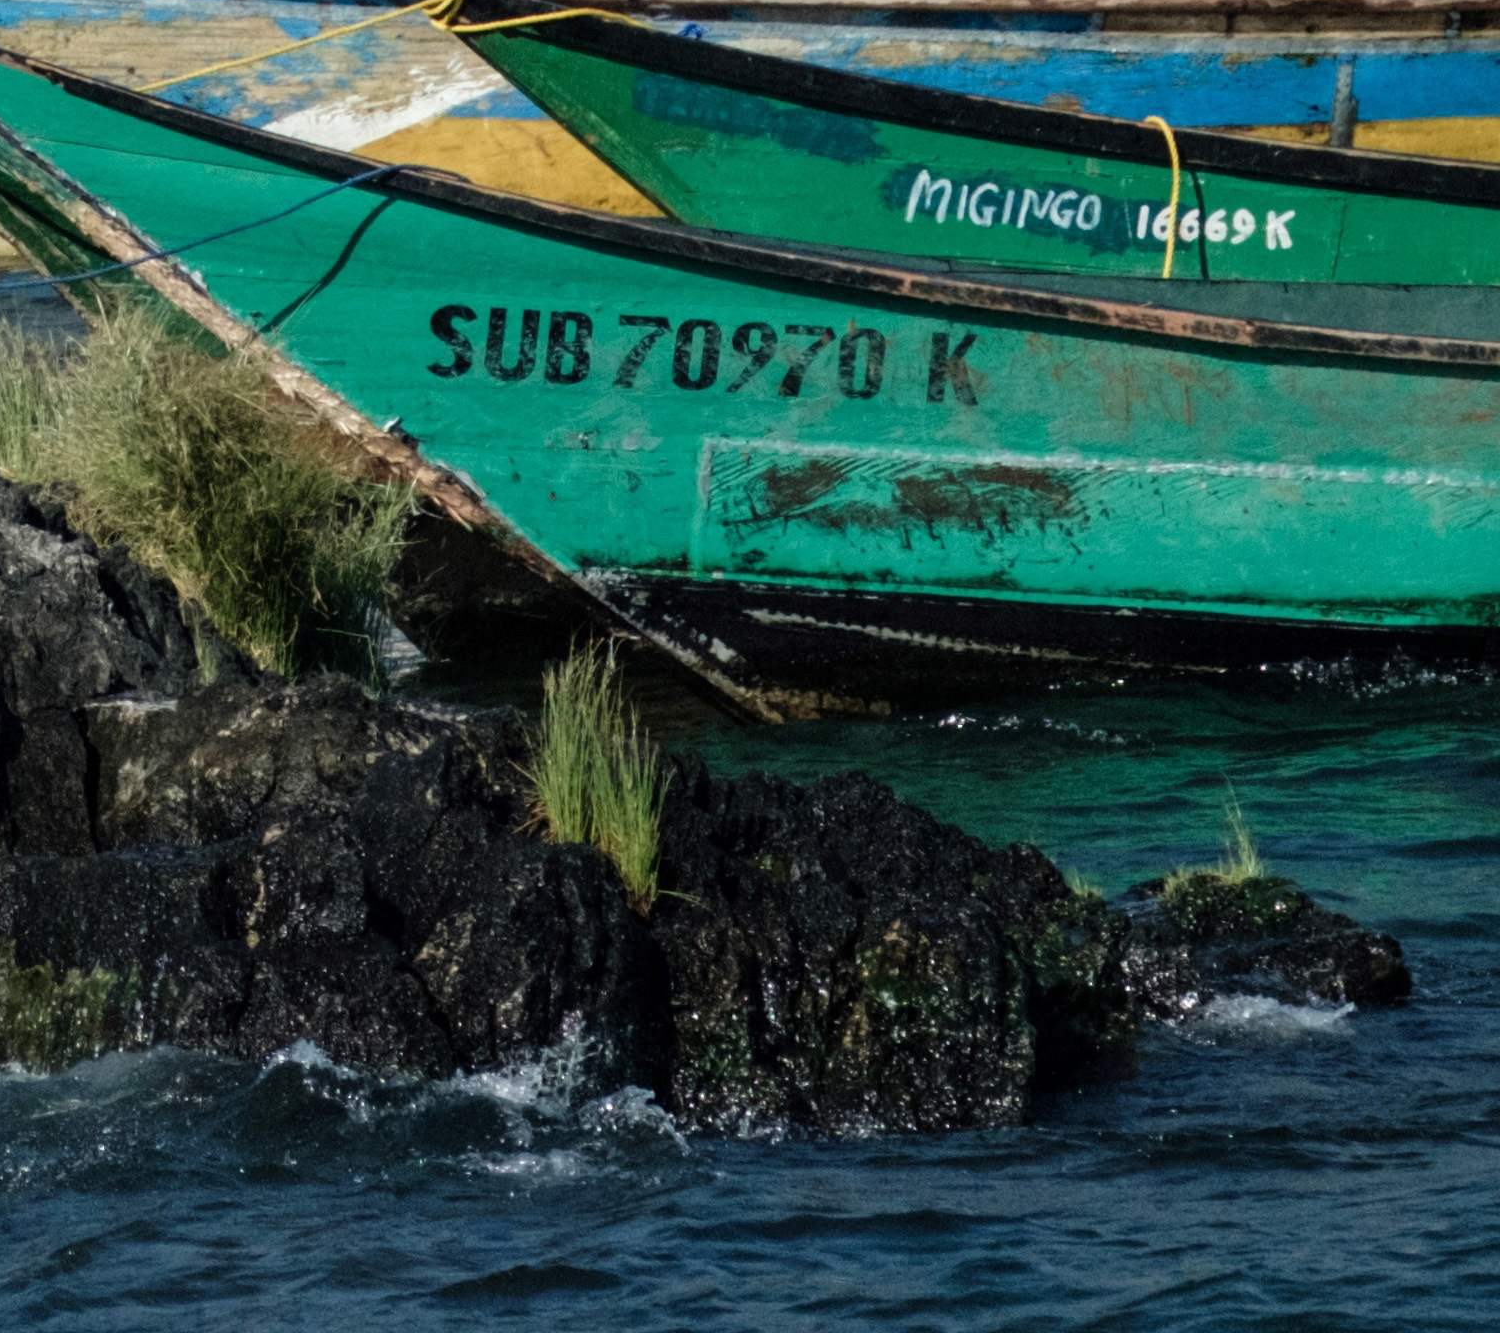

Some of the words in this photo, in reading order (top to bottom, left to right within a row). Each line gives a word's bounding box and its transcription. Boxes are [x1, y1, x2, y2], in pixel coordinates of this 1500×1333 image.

[906, 169, 1102, 231] MIGINGO
[426, 304, 594, 385] SUB
[613, 314, 886, 400] 70970
[926, 331, 979, 406] K
